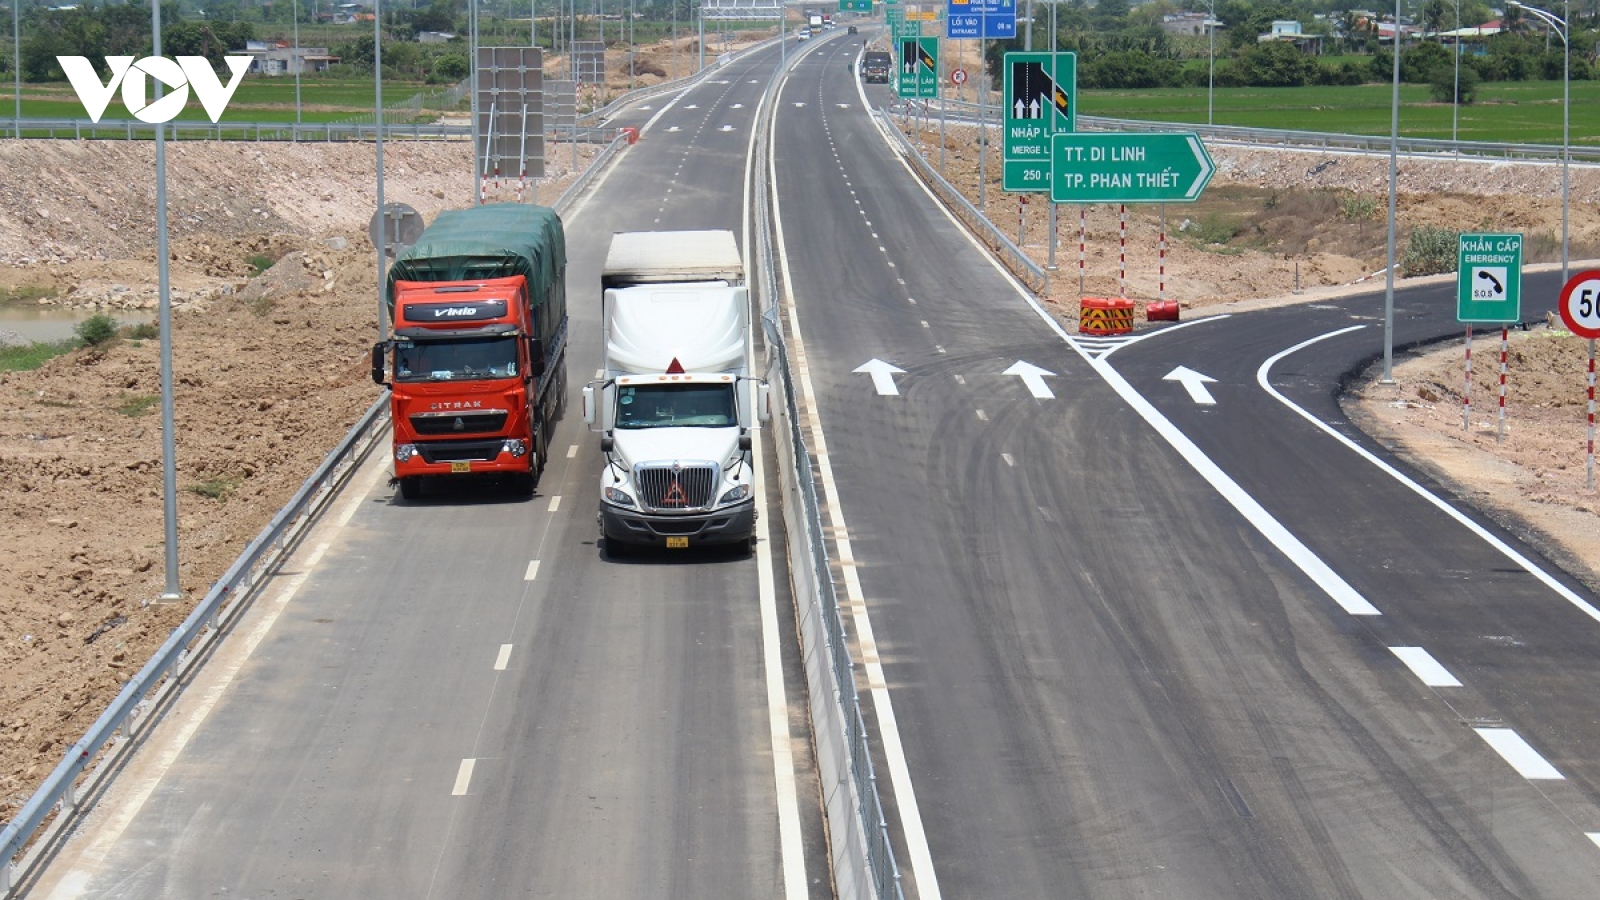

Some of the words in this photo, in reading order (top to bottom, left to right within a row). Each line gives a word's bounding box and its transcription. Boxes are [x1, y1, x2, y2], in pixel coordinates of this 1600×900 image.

[1011, 123, 1041, 141] NHẬP
[1012, 145, 1041, 154] MERGE
[1064, 147, 1086, 162] TT.
[1090, 147, 1105, 162] DI
[1111, 147, 1145, 162] LINH
[1023, 169, 1041, 181] 250
[1064, 173, 1086, 188] TP.
[1090, 173, 1132, 188] PHAN
[1136, 166, 1180, 188] THIẾT
[1462, 235, 1492, 252] KHẨN
[1496, 237, 1520, 252] CẤP
[1465, 254, 1515, 264] EMERGENCY
